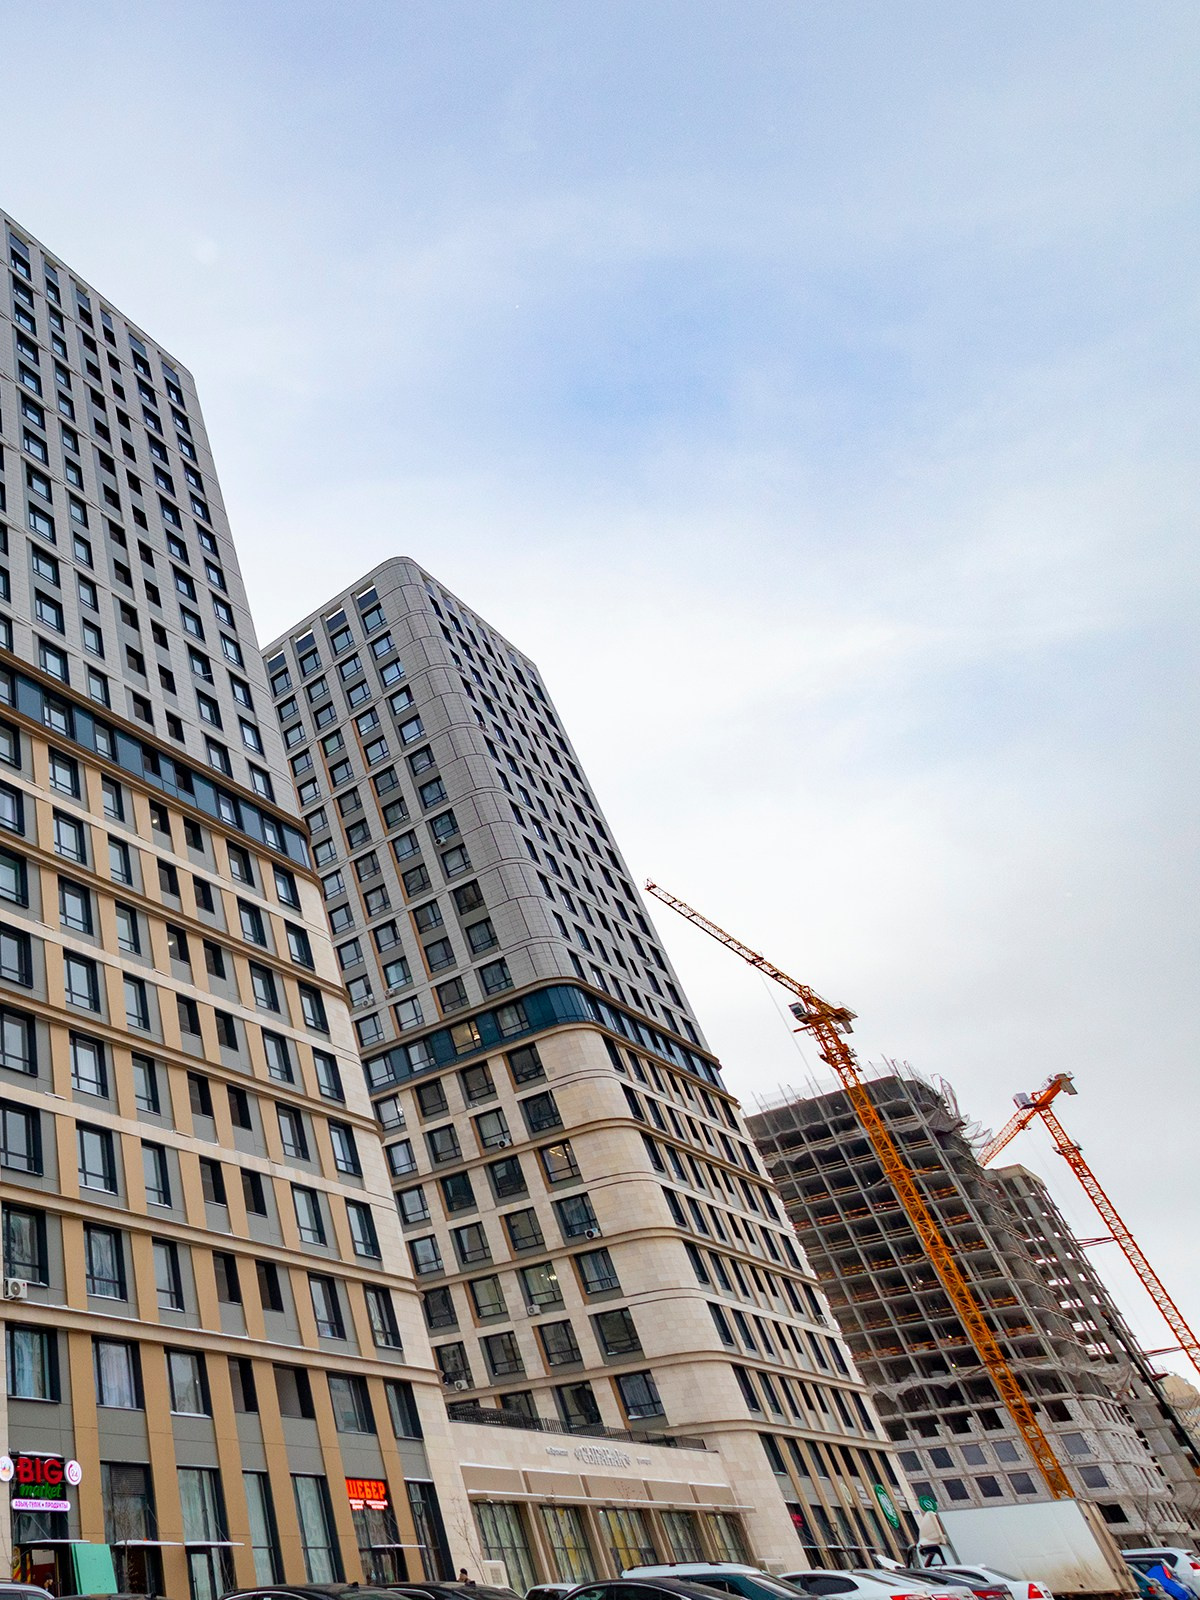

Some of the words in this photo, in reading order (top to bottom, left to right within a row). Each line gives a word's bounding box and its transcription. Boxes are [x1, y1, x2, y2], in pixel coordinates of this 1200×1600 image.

[16, 1457, 63, 1485] BIG
[20, 1482, 62, 1499] market
[346, 1480, 386, 1500] ШЕБЕР
